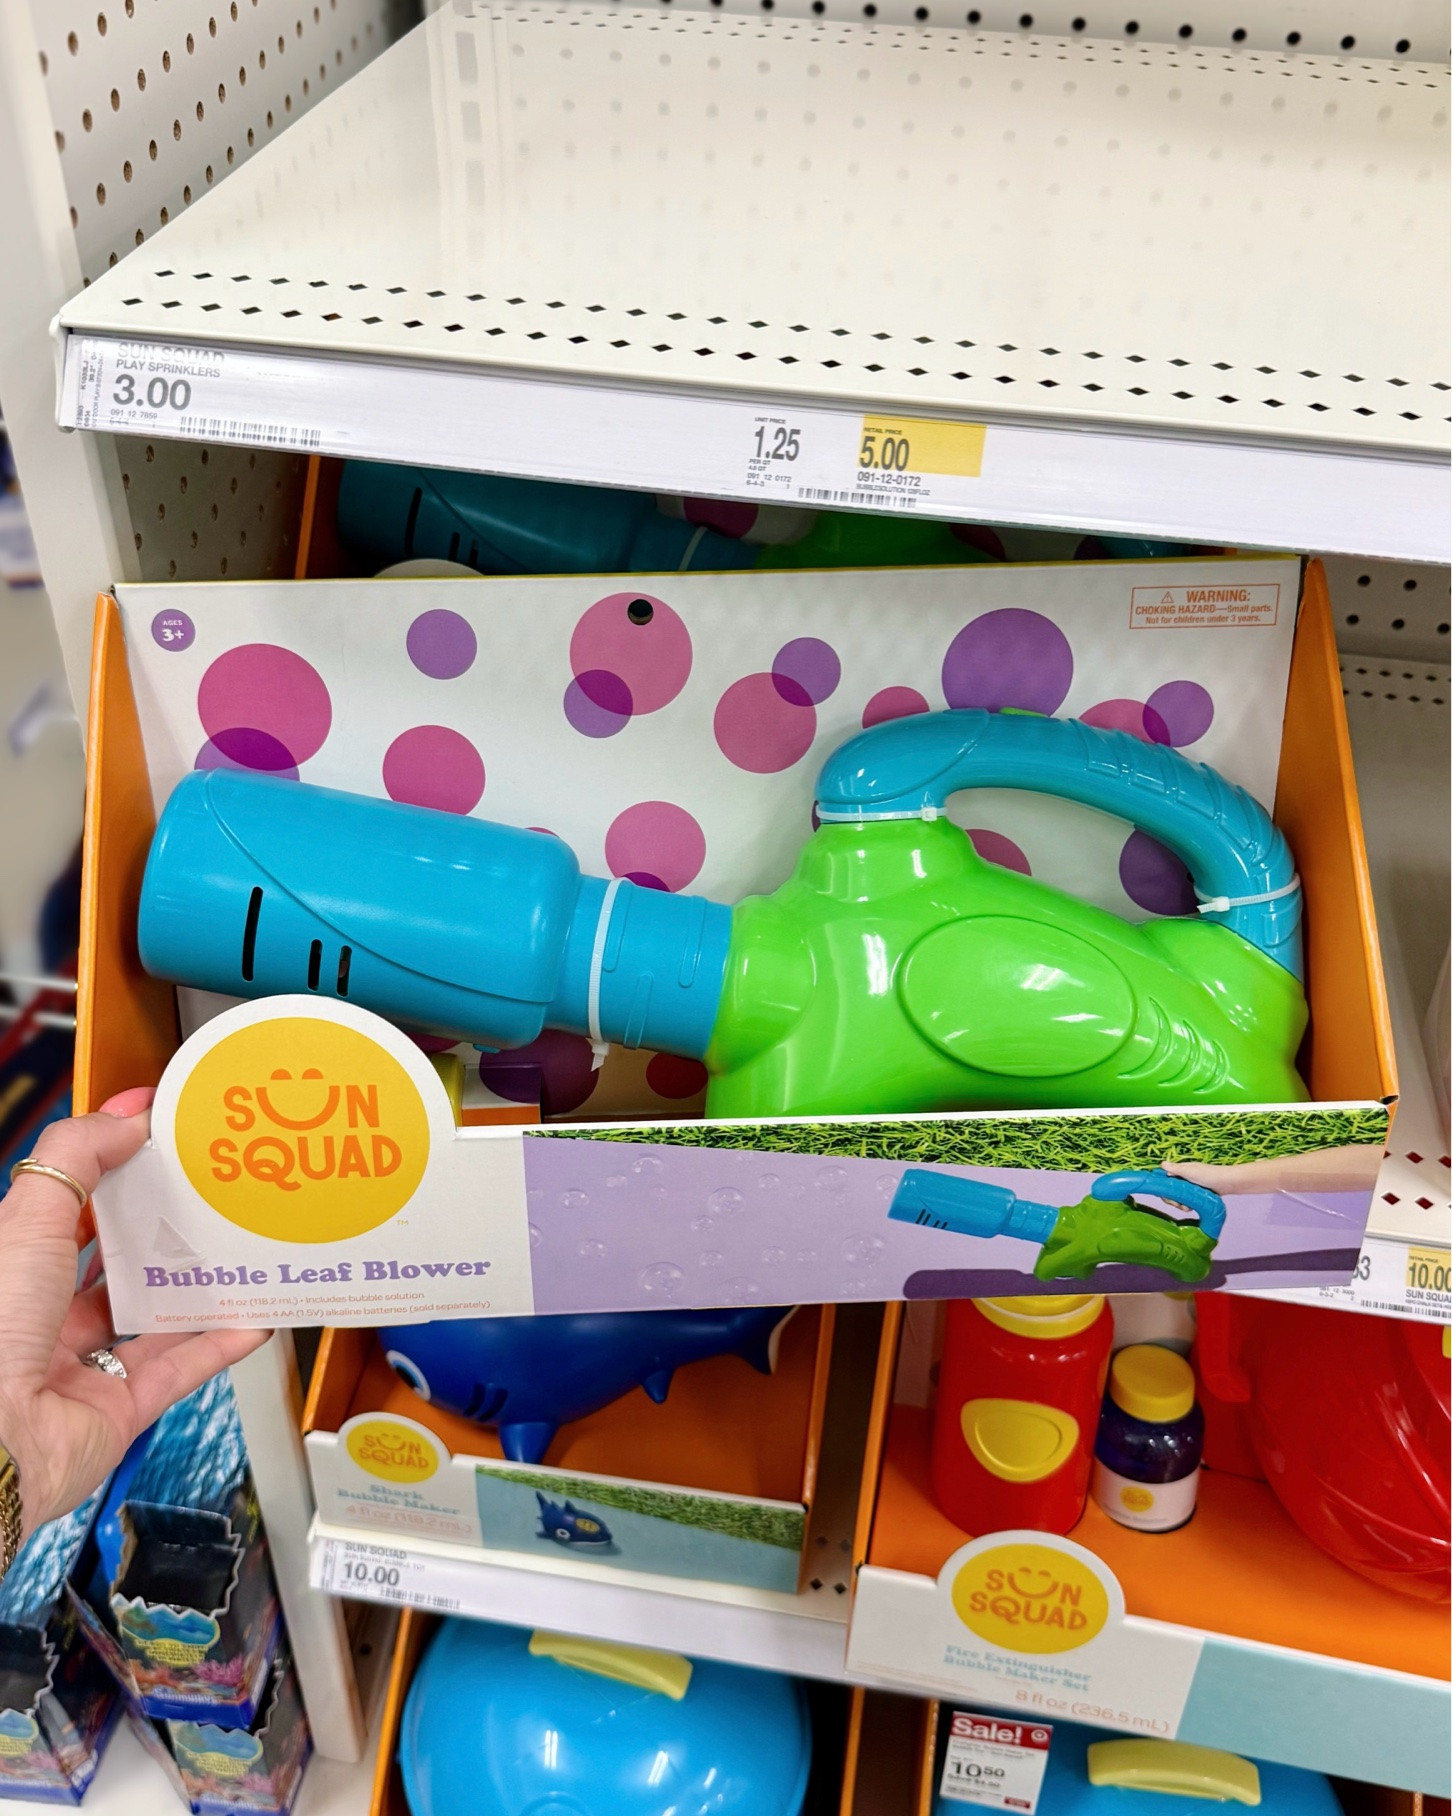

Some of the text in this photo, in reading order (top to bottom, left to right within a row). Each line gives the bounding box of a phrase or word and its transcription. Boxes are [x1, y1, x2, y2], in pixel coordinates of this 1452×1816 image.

[118, 342, 155, 360] SUN
[116, 359, 220, 378] PLAY SPRINKLERS
[113, 374, 192, 411] 3.00
[110, 408, 124, 416] 091
[128, 410, 136, 418] 12
[754, 426, 801, 461] 1.25
[859, 436, 910, 471] 5.00
[775, 475, 792, 483] 0172
[857, 471, 921, 487] 091-12-0172
[1186, 589, 1251, 603] WARNING:
[1135, 605, 1176, 615] CHOKING
[1250, 605, 1272, 613] parts.
[1145, 616, 1159, 624] Not
[1161, 615, 1171, 624] for
[1173, 615, 1205, 623] children
[1207, 615, 1229, 623] under
[1238, 615, 1261, 623] years.
[162, 628, 184, 642] 3+
[223, 1084, 380, 1132] SUN
[209, 1134, 403, 1192] SQUAD
[143, 1259, 491, 1287] Bubble Leaf Blower
[249, 1298, 277, 1307] (118.2
[305, 1296, 347, 1304] Includes
[349, 1294, 384, 1302] bubble
[385, 1292, 424, 1300] solution
[1405, 1289, 1424, 1299] SUN
[1425, 1292, 1451, 1303] SQUA
[155, 1314, 191, 1323] Battery
[193, 1313, 240, 1322] operated
[326, 1308, 361, 1316] alkaline
[363, 1306, 408, 1315] batteries
[409, 1304, 434, 1313] (sold
[436, 1301, 491, 1310] separately)
[363, 1434, 421, 1454] SUN
[359, 1447, 429, 1468] SQUAD
[337, 1488, 460, 1514] Bubble Maker
[370, 1484, 424, 1500] Shark
[345, 1541, 367, 1552] SUN
[370, 1545, 407, 1559] SQUAD
[345, 1561, 400, 1586] 10.00
[985, 1568, 1082, 1607] SUN
[969, 1590, 1088, 1630] SQUAD
[943, 1654, 1000, 1673] Bubble
[1004, 1665, 1060, 1685] Maker
[1062, 1677, 1090, 1692] Set
[946, 1644, 980, 1659] Fire
[984, 1650, 1092, 1682] Extinguisher
[1015, 1690, 1028, 1702] 8
[1048, 1698, 1068, 1711] oz
[1071, 1701, 1130, 1724] (236.5
[952, 1717, 1022, 1744] Sale!
